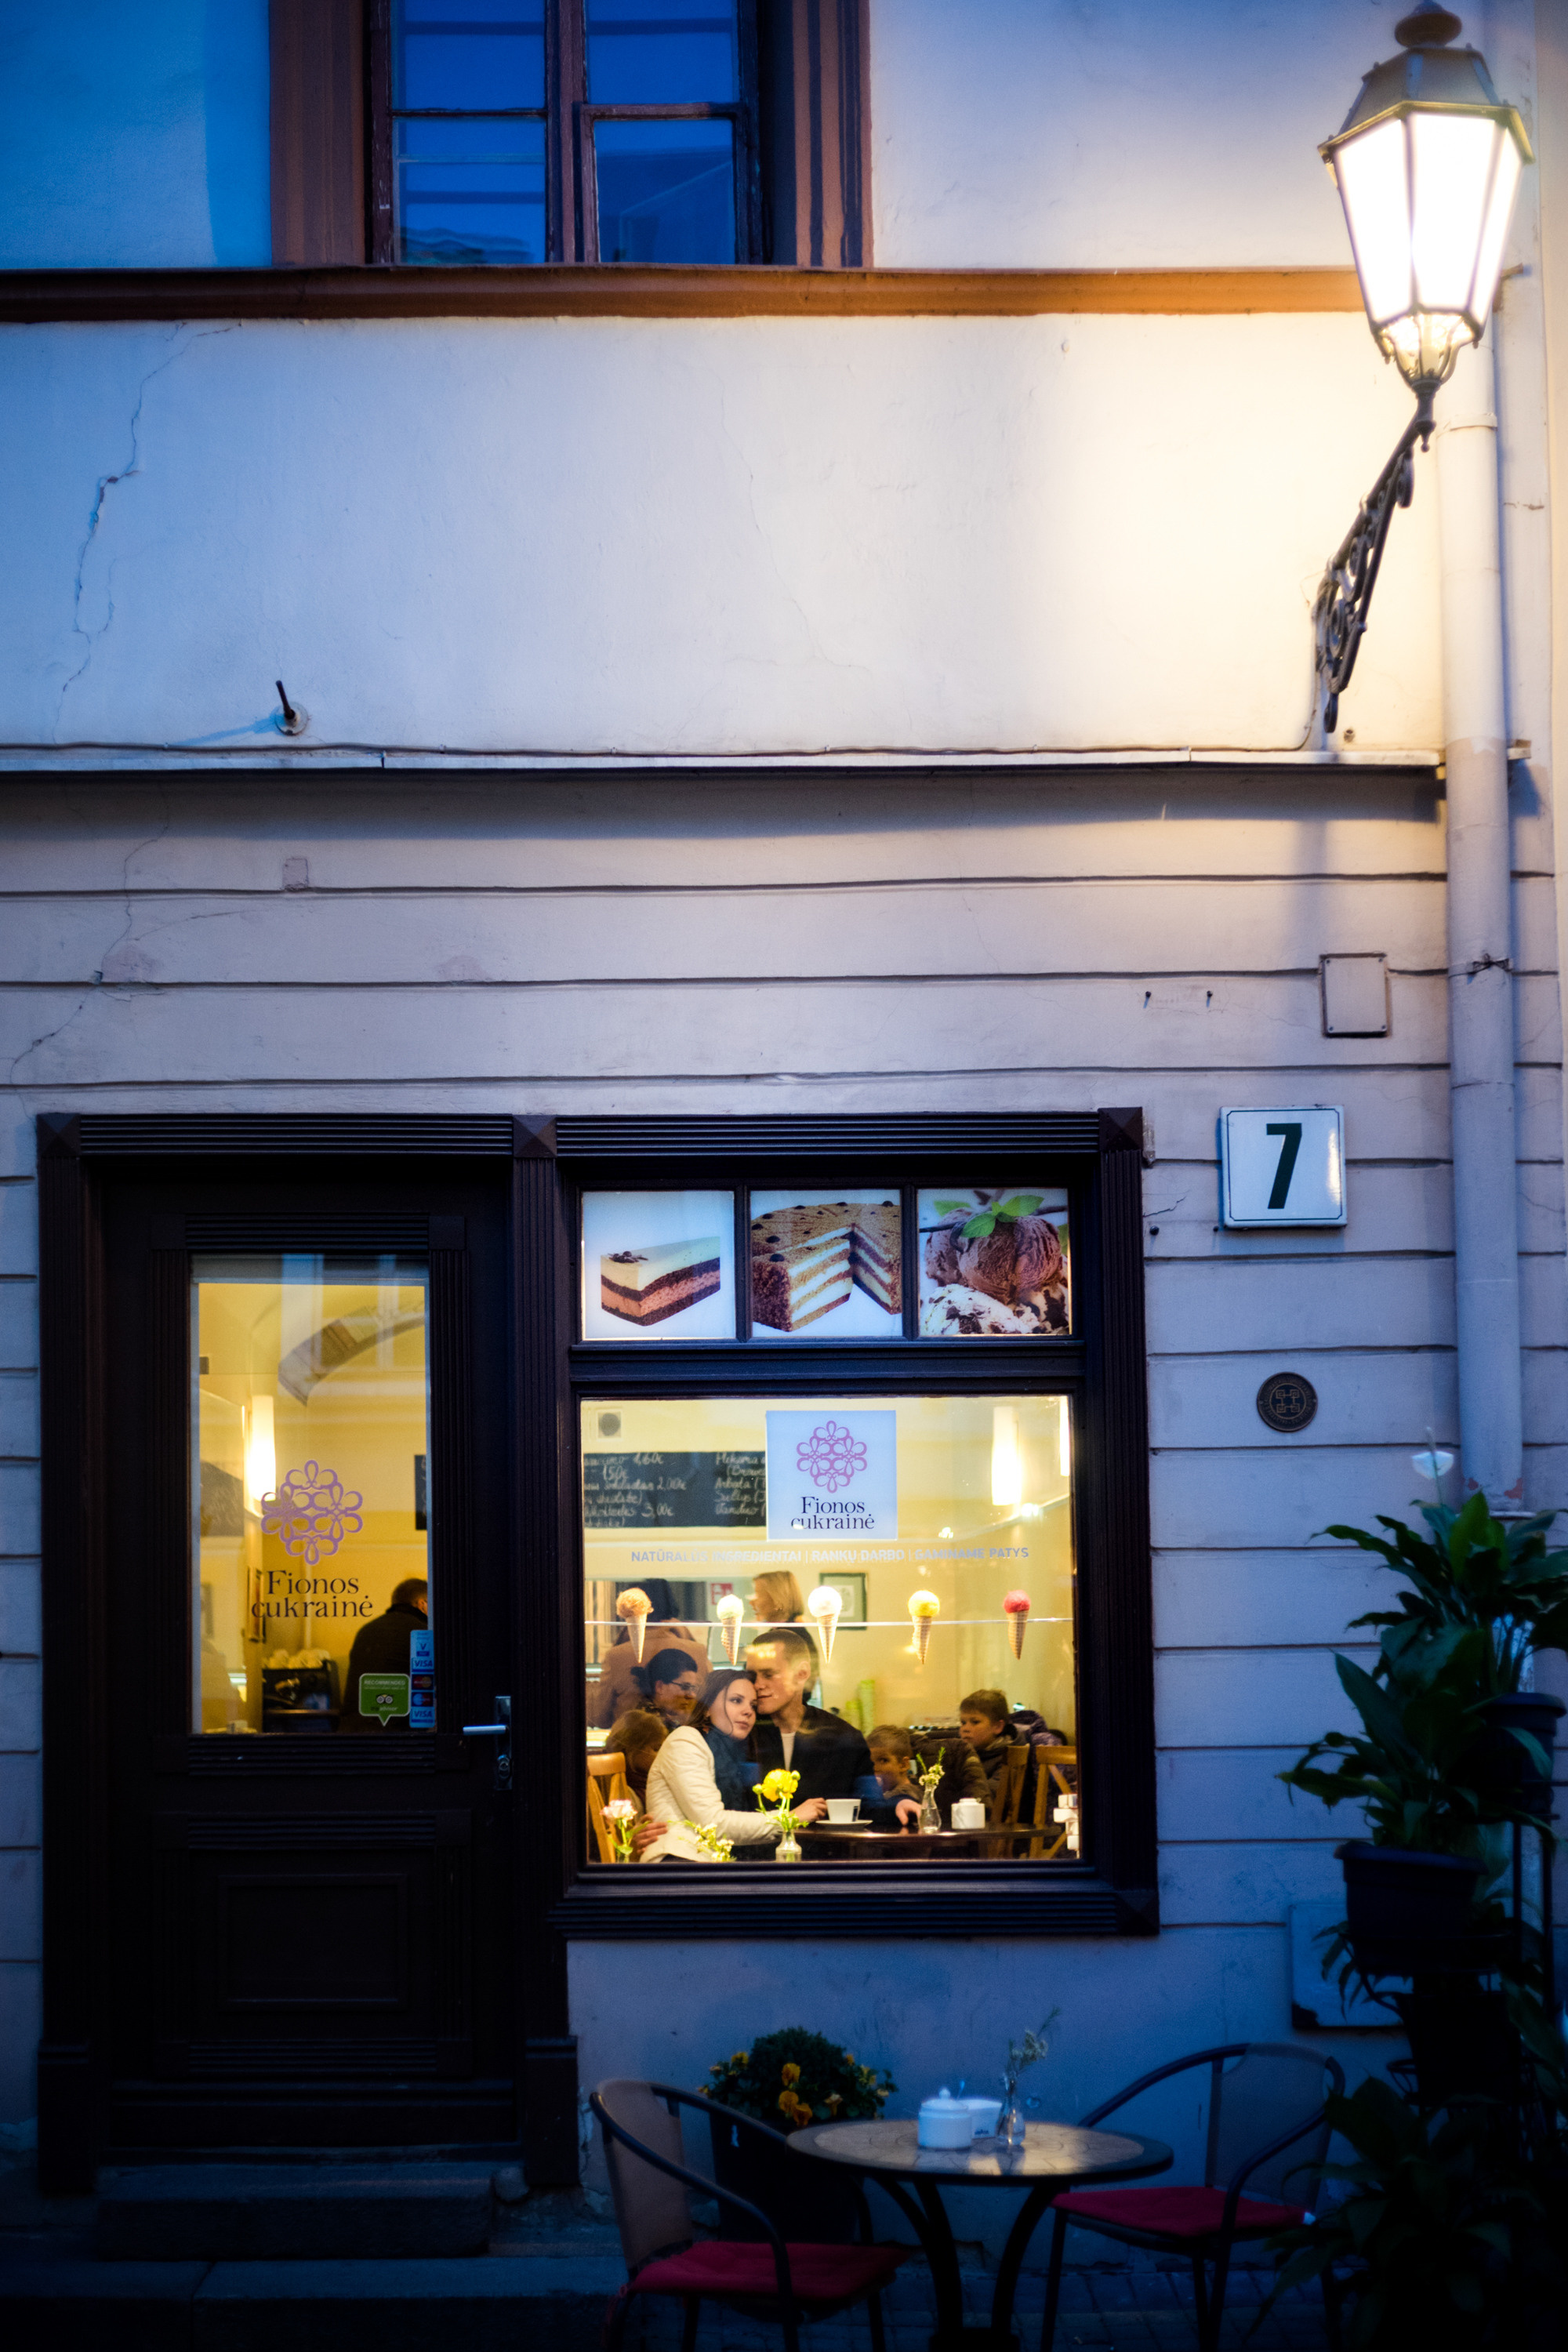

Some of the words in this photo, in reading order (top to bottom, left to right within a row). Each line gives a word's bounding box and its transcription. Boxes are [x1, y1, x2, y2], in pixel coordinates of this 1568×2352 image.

[1266, 1123, 1302, 1209] 7
[800, 1496, 866, 1514] Fionos
[790, 1513, 875, 1530] cukrainė
[631, 1549, 709, 1563] NATŪRALŪS
[712, 1549, 802, 1563] INGREDIENTAI
[811, 1549, 858, 1564] RANKŲ
[862, 1548, 906, 1561] DARBO
[915, 1547, 985, 1560] GAMINAME
[989, 1546, 1029, 1559] PATYS
[267, 1570, 360, 1595] Fionos
[251, 1595, 373, 1617] cukrainė
